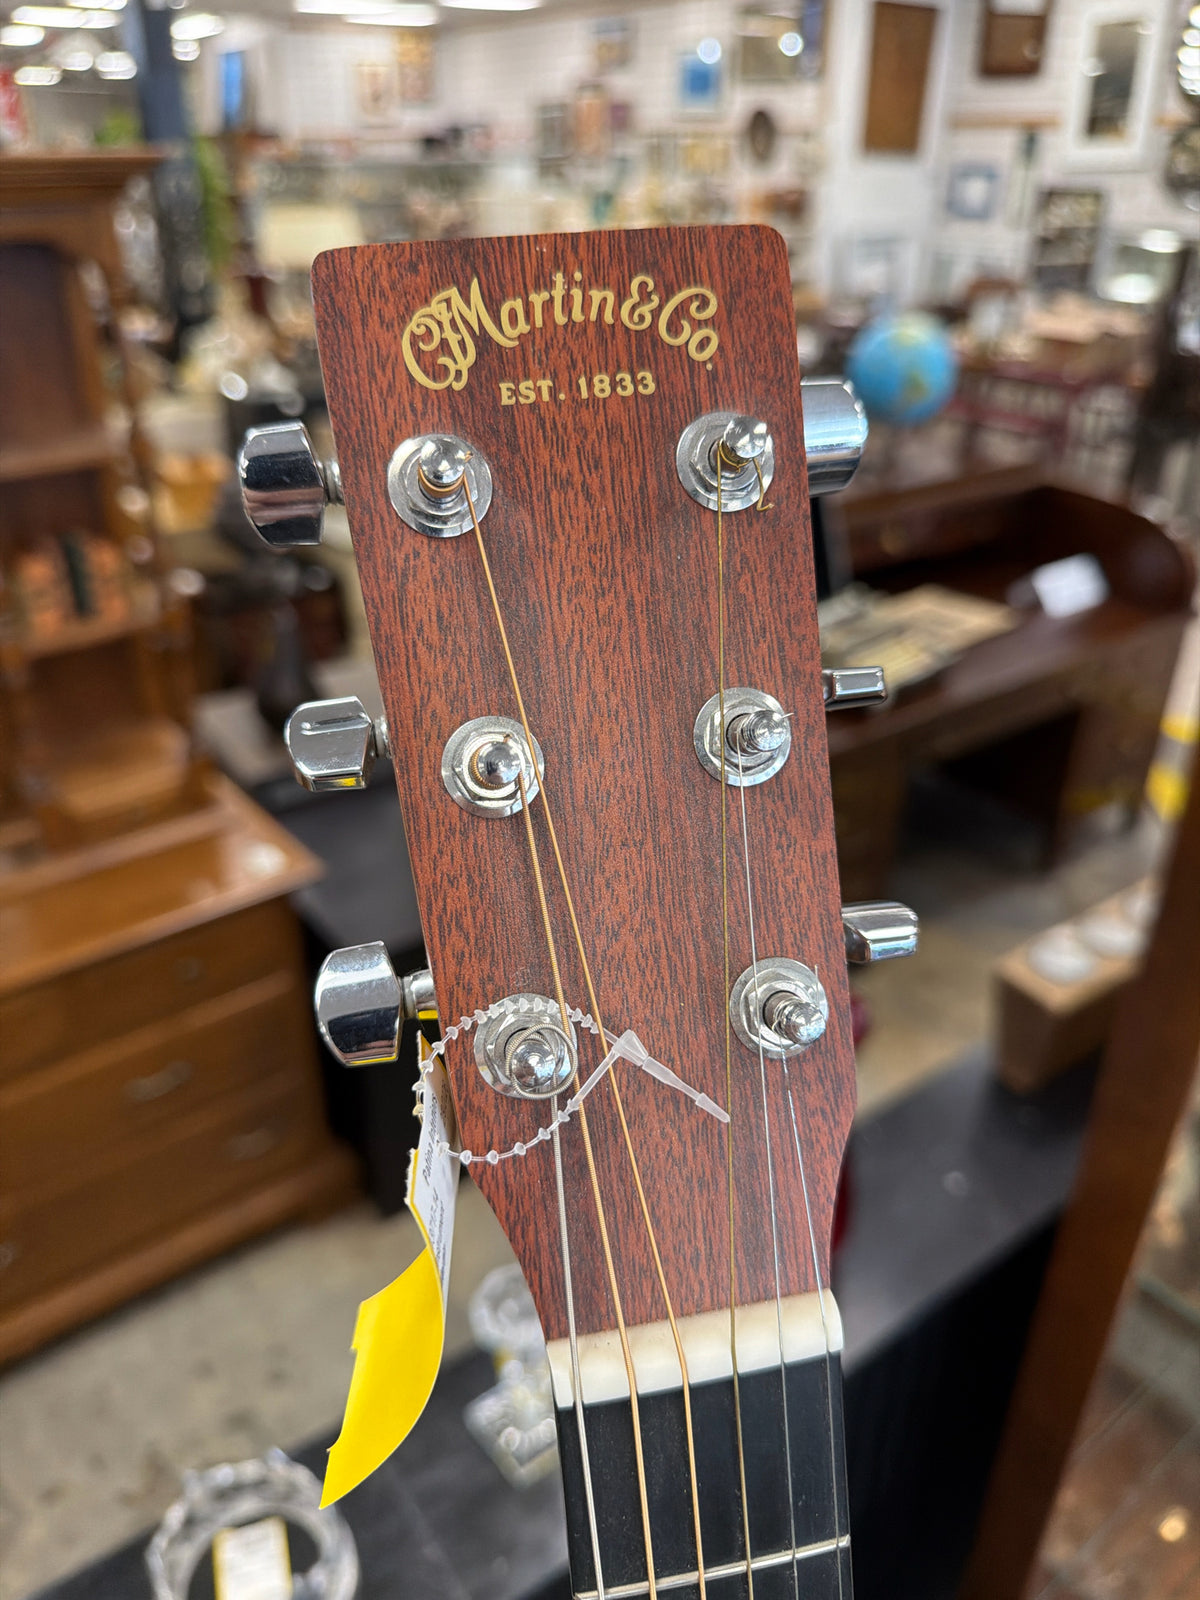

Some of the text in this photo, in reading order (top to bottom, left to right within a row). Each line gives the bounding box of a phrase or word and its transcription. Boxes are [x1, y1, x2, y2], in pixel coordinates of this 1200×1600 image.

[499, 372, 656, 406] EST. 1833
[423, 1142, 435, 1186] Patina
